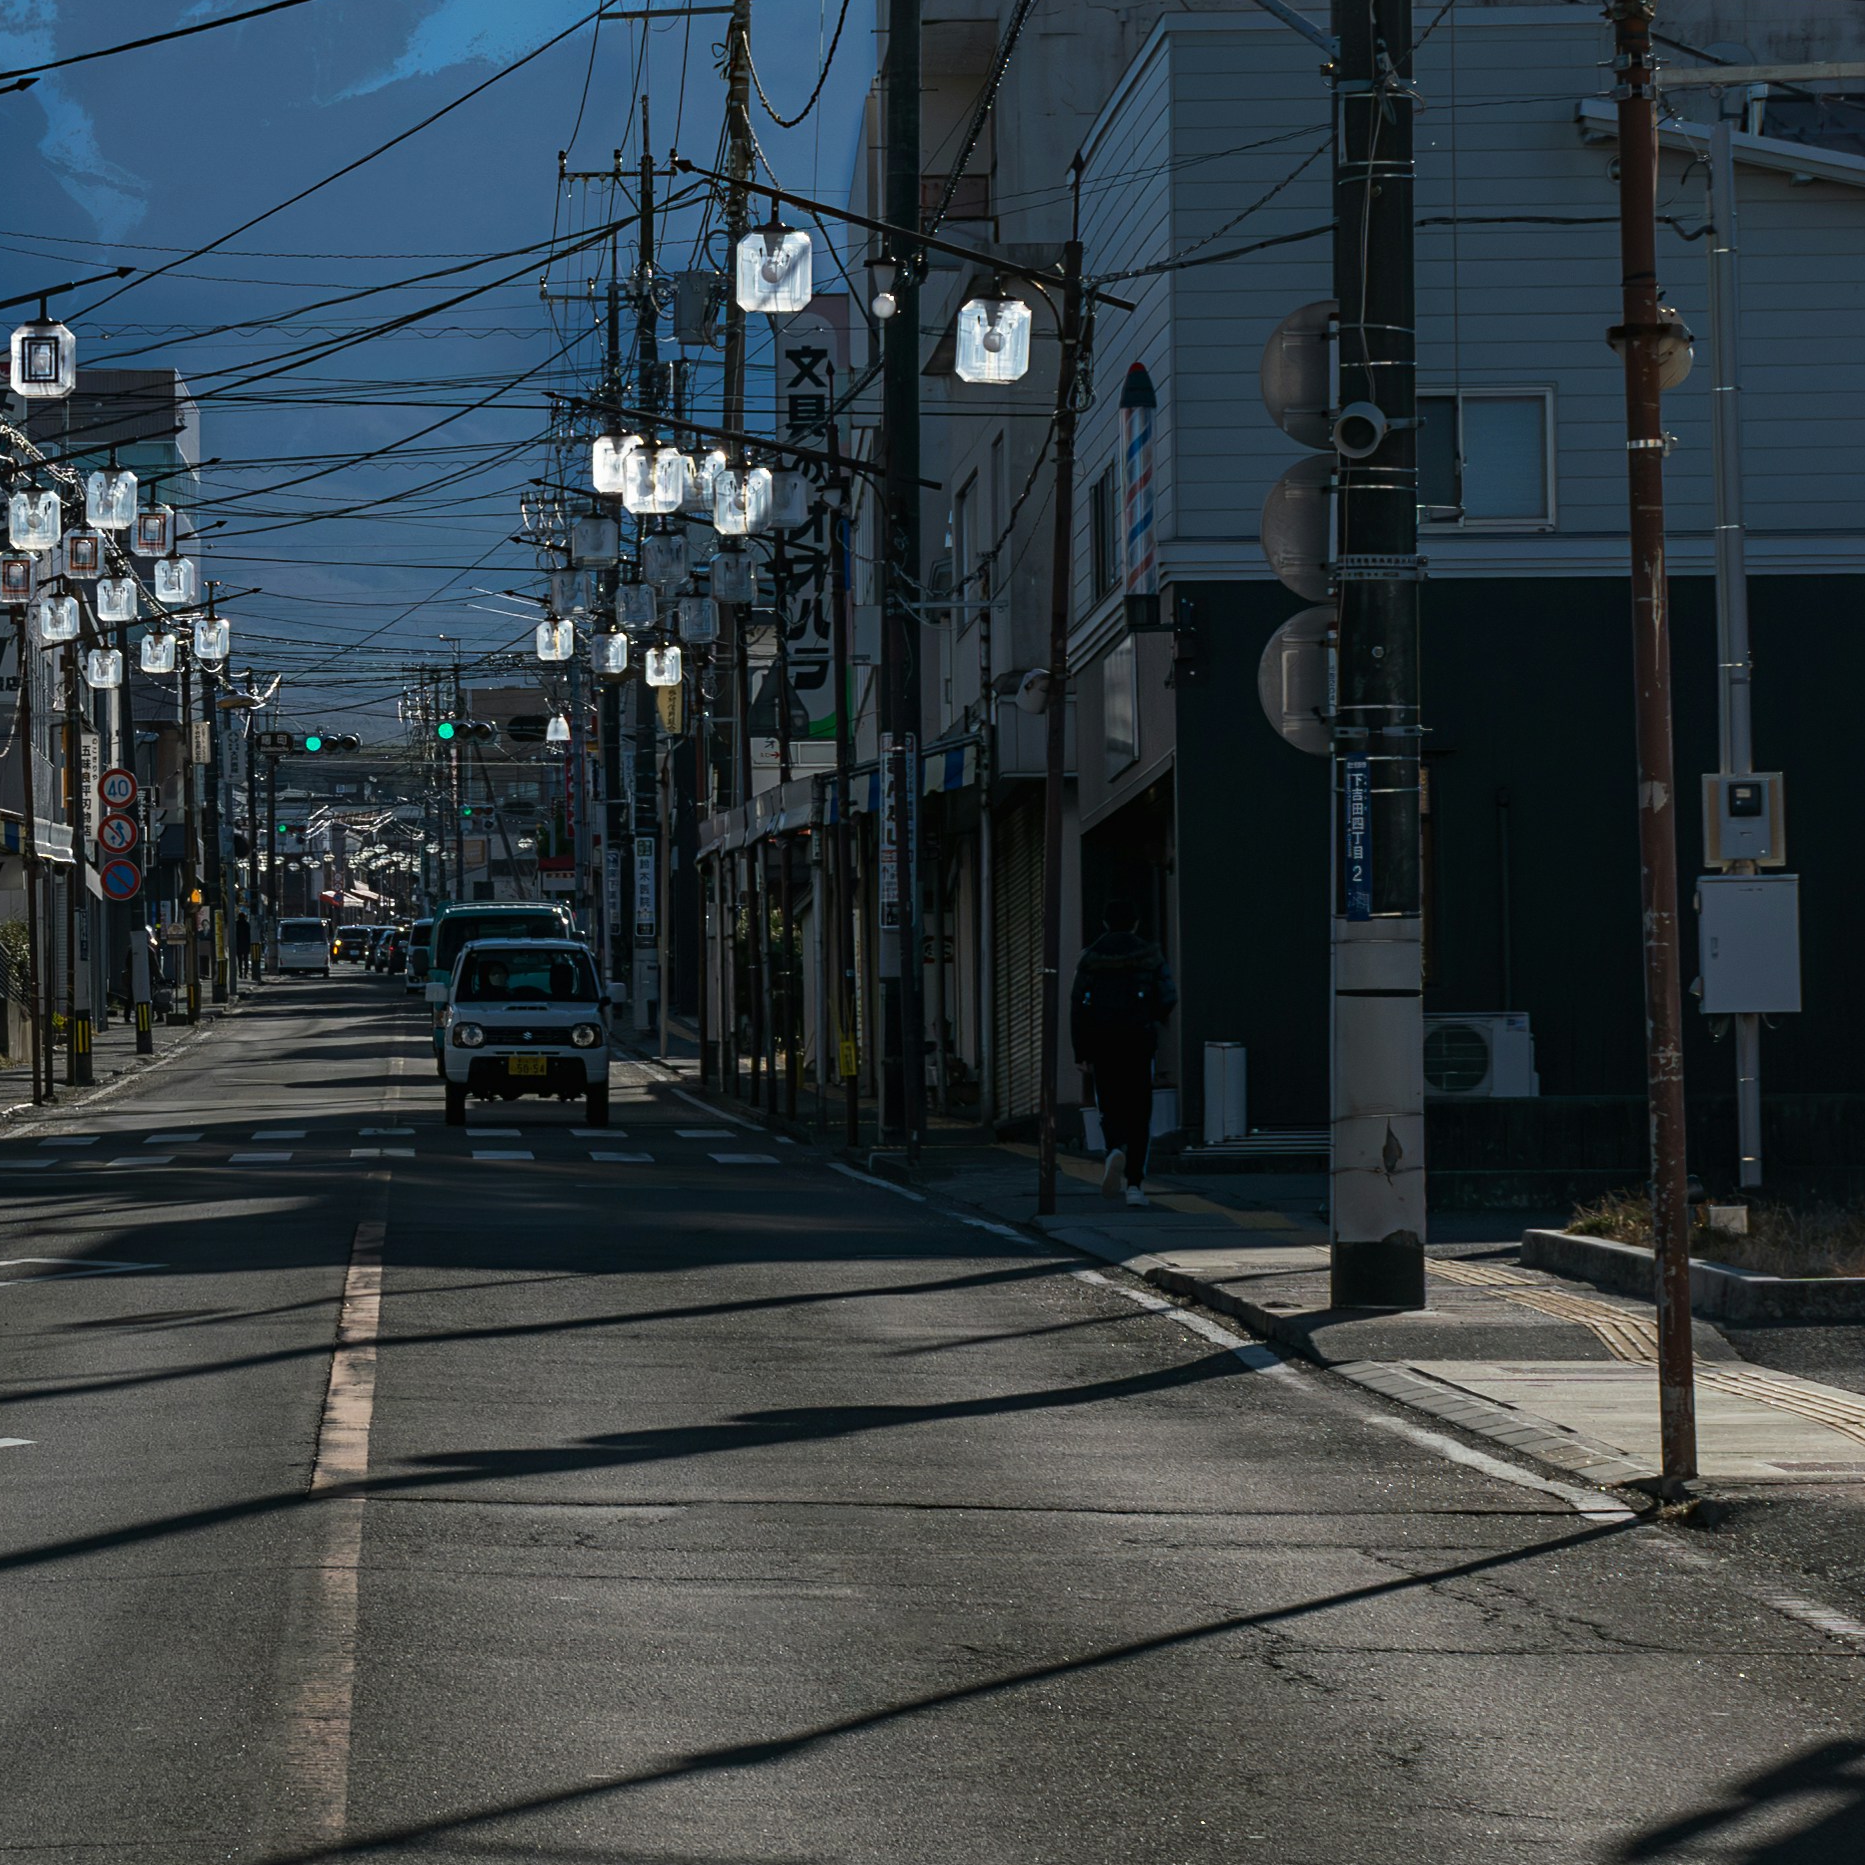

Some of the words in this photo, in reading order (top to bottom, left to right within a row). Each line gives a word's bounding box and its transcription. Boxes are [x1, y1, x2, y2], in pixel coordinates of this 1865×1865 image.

[108, 780, 129, 797] 40
[1351, 772, 1364, 860] 下吉田四丁目
[1352, 865, 1363, 882] 2
